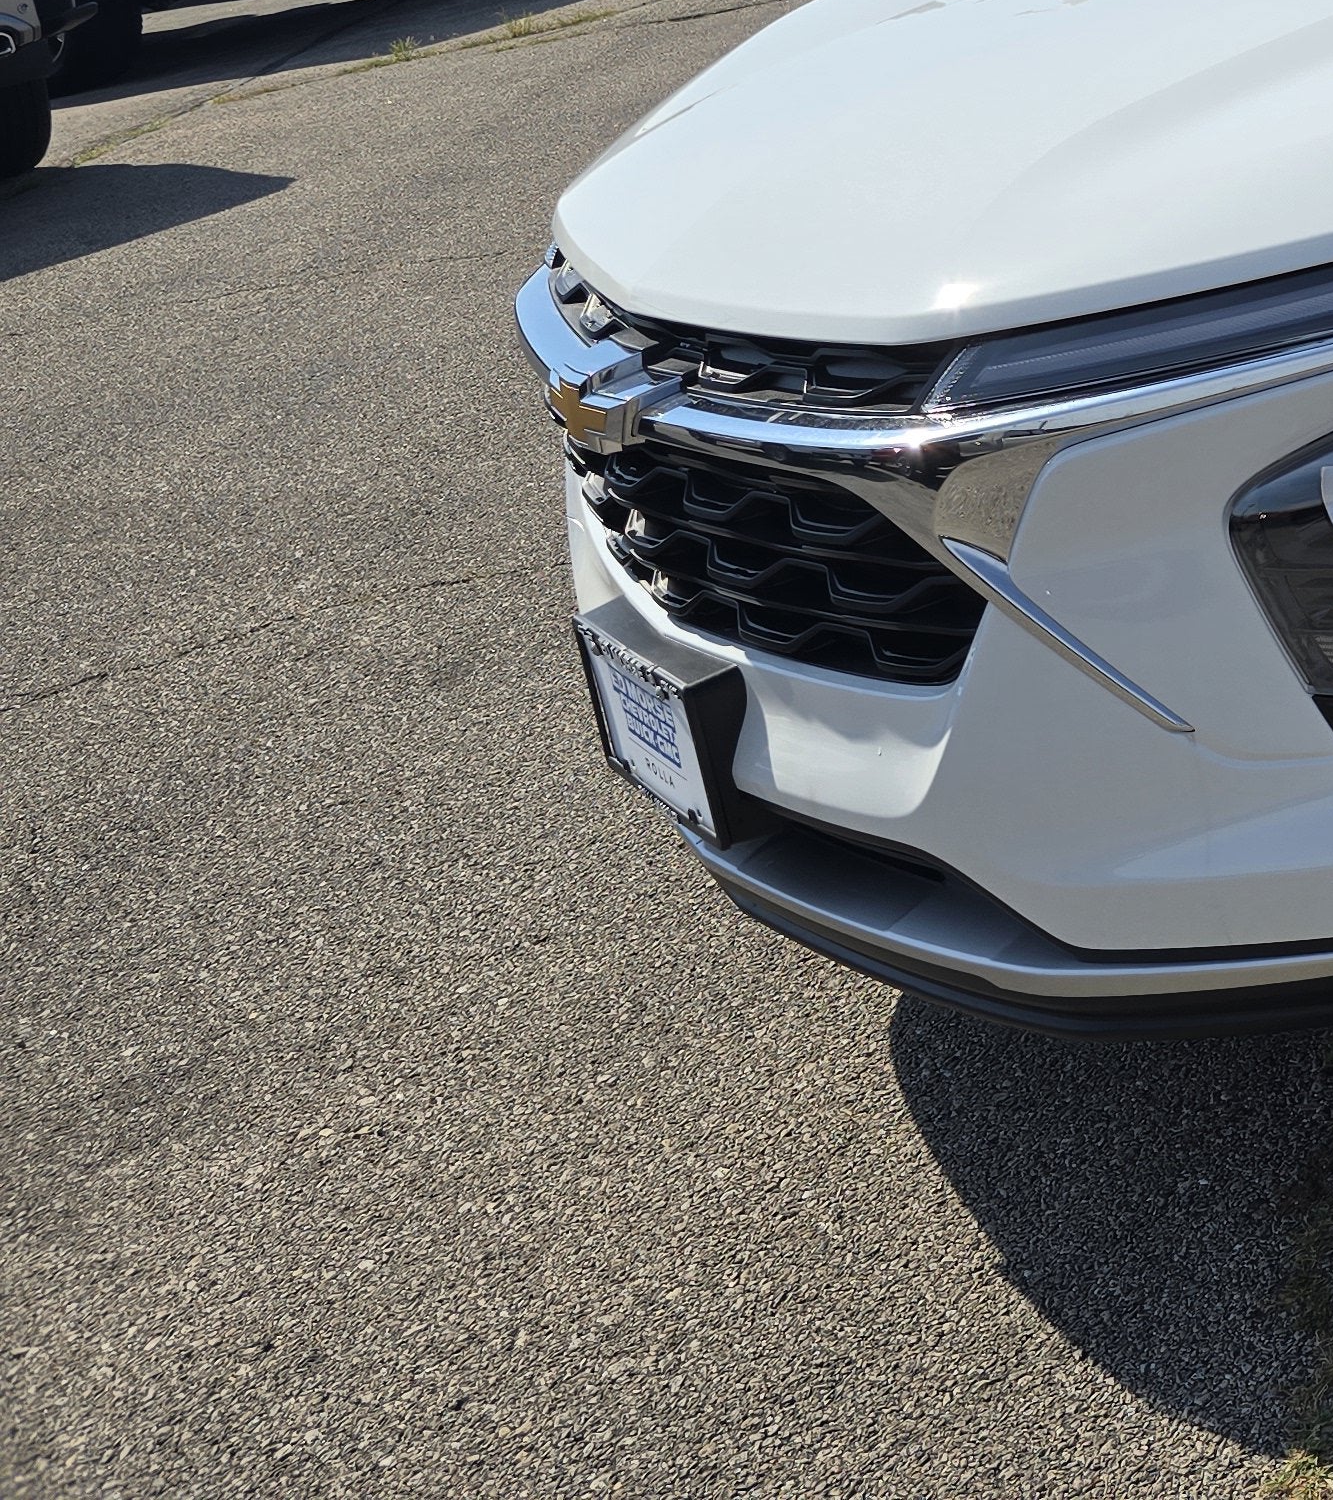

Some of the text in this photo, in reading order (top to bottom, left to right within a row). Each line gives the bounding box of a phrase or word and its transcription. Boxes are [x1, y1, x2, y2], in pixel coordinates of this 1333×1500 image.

[621, 696, 676, 744] CHEVROLET
[625, 679, 675, 728] MORSE
[645, 757, 676, 788] ROLLA
